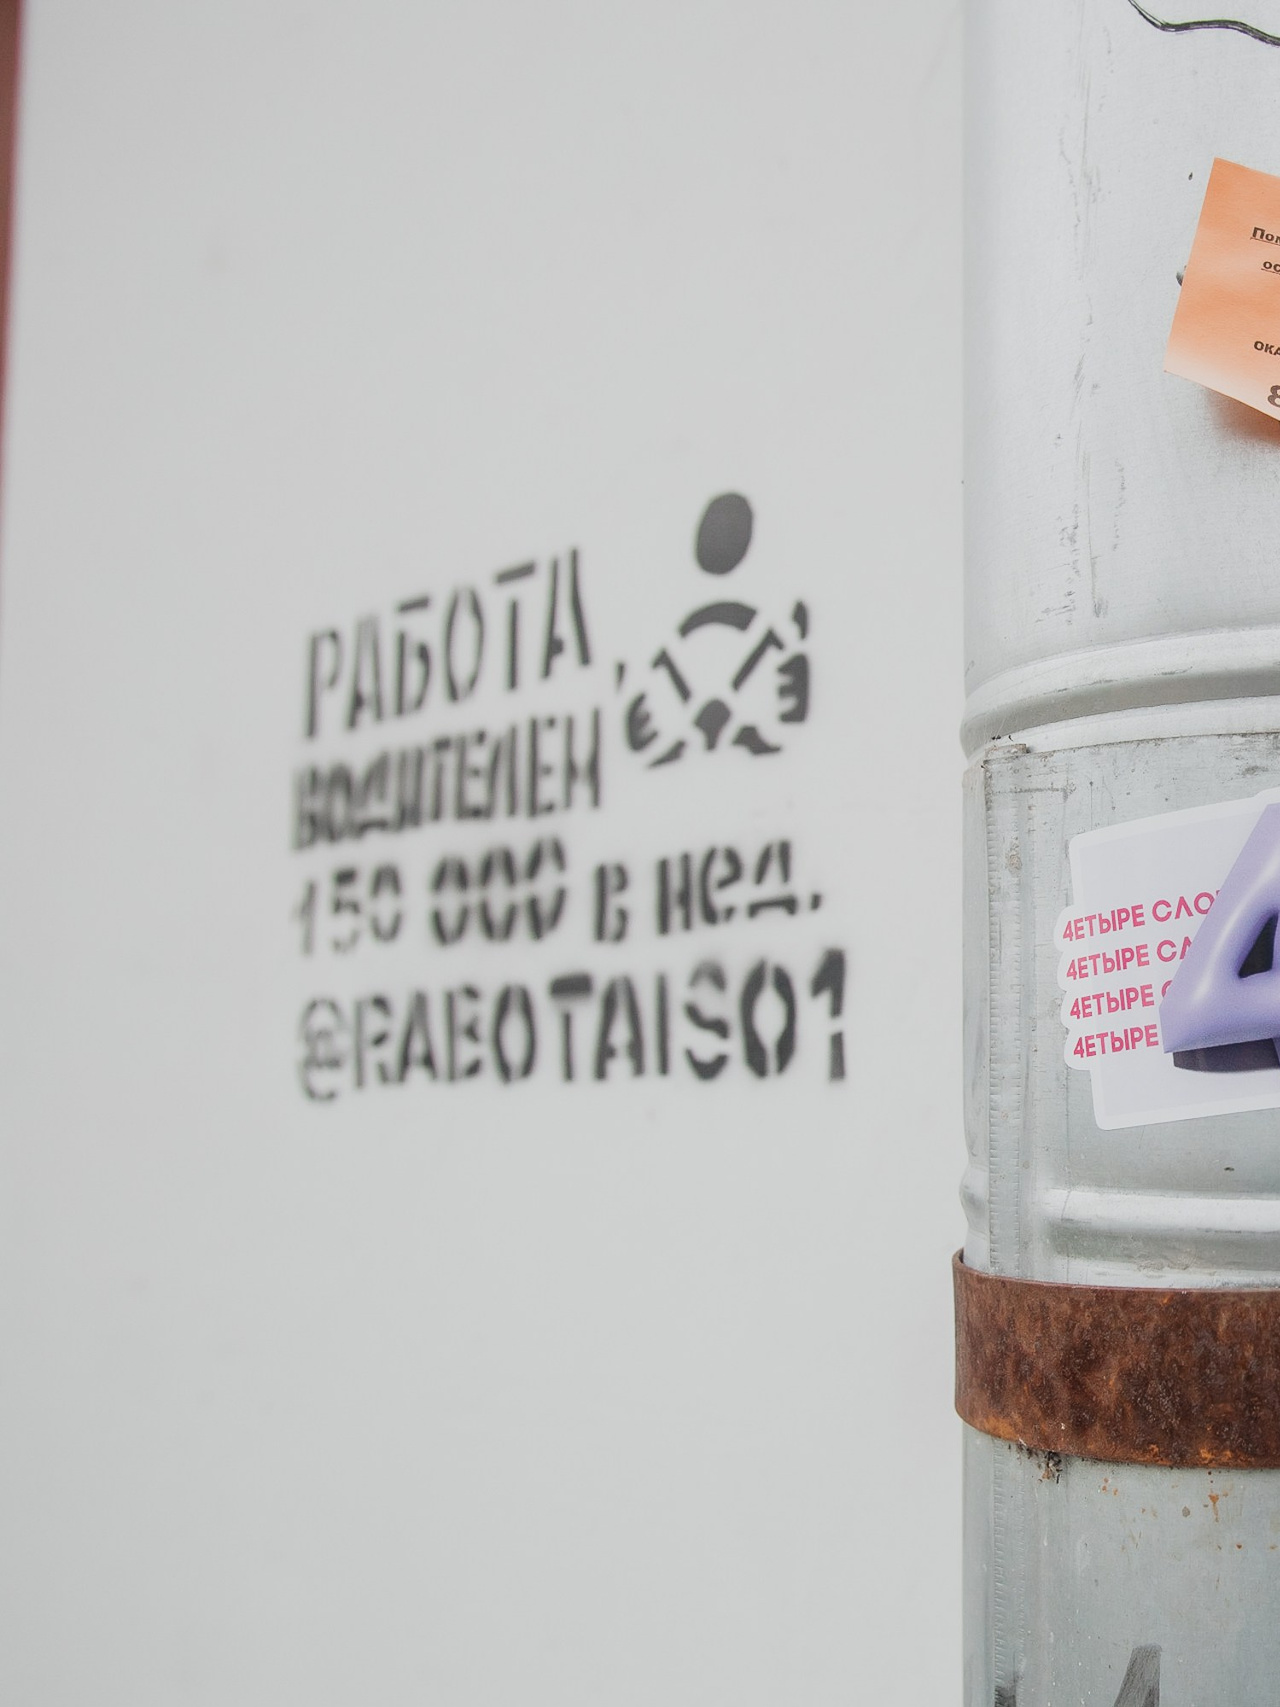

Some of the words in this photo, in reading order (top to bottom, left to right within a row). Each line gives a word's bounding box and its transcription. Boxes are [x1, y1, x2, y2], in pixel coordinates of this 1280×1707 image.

[306, 546, 591, 740] РАБОТА
[296, 862, 402, 955] 150
[432, 837, 567, 947] 000
[1152, 890, 1221, 923] СЛО
